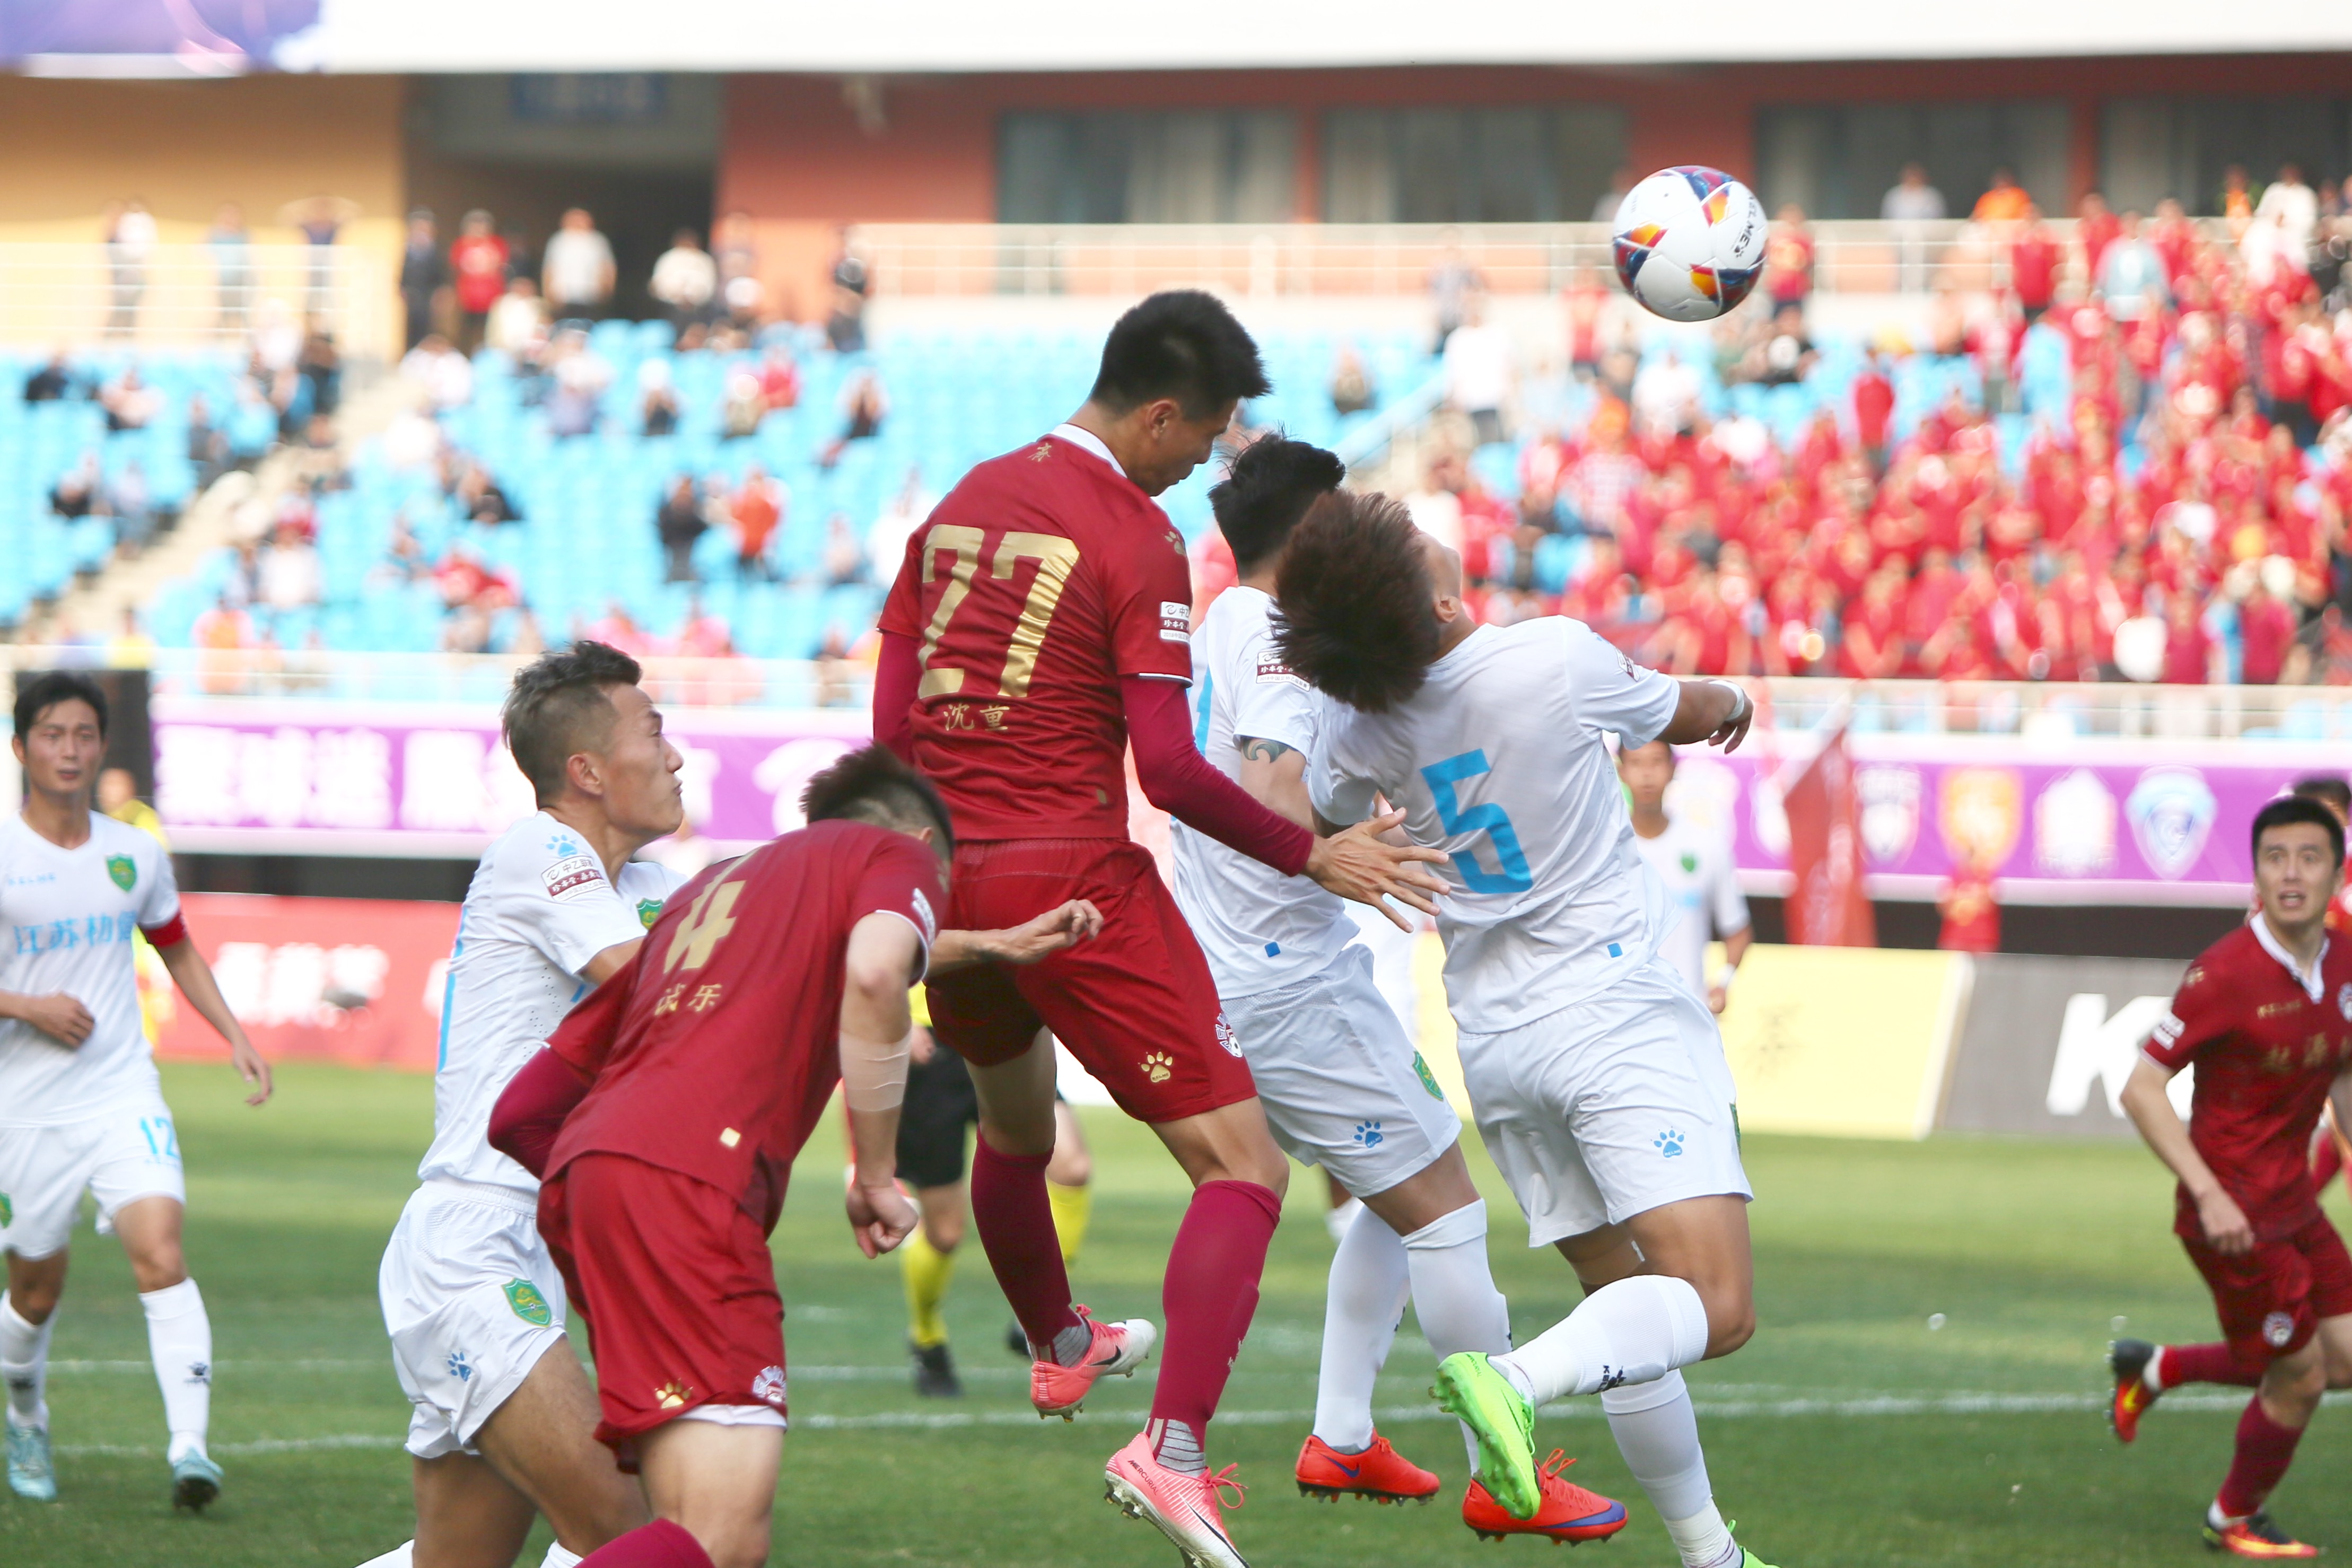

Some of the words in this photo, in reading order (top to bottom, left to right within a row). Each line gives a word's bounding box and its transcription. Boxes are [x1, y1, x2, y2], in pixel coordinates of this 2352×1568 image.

[918, 523, 1080, 699] 27
[1420, 748, 1533, 894] 5
[139, 1117, 179, 1160] 12
[1127, 1460, 1158, 1495] MERCURIAL
